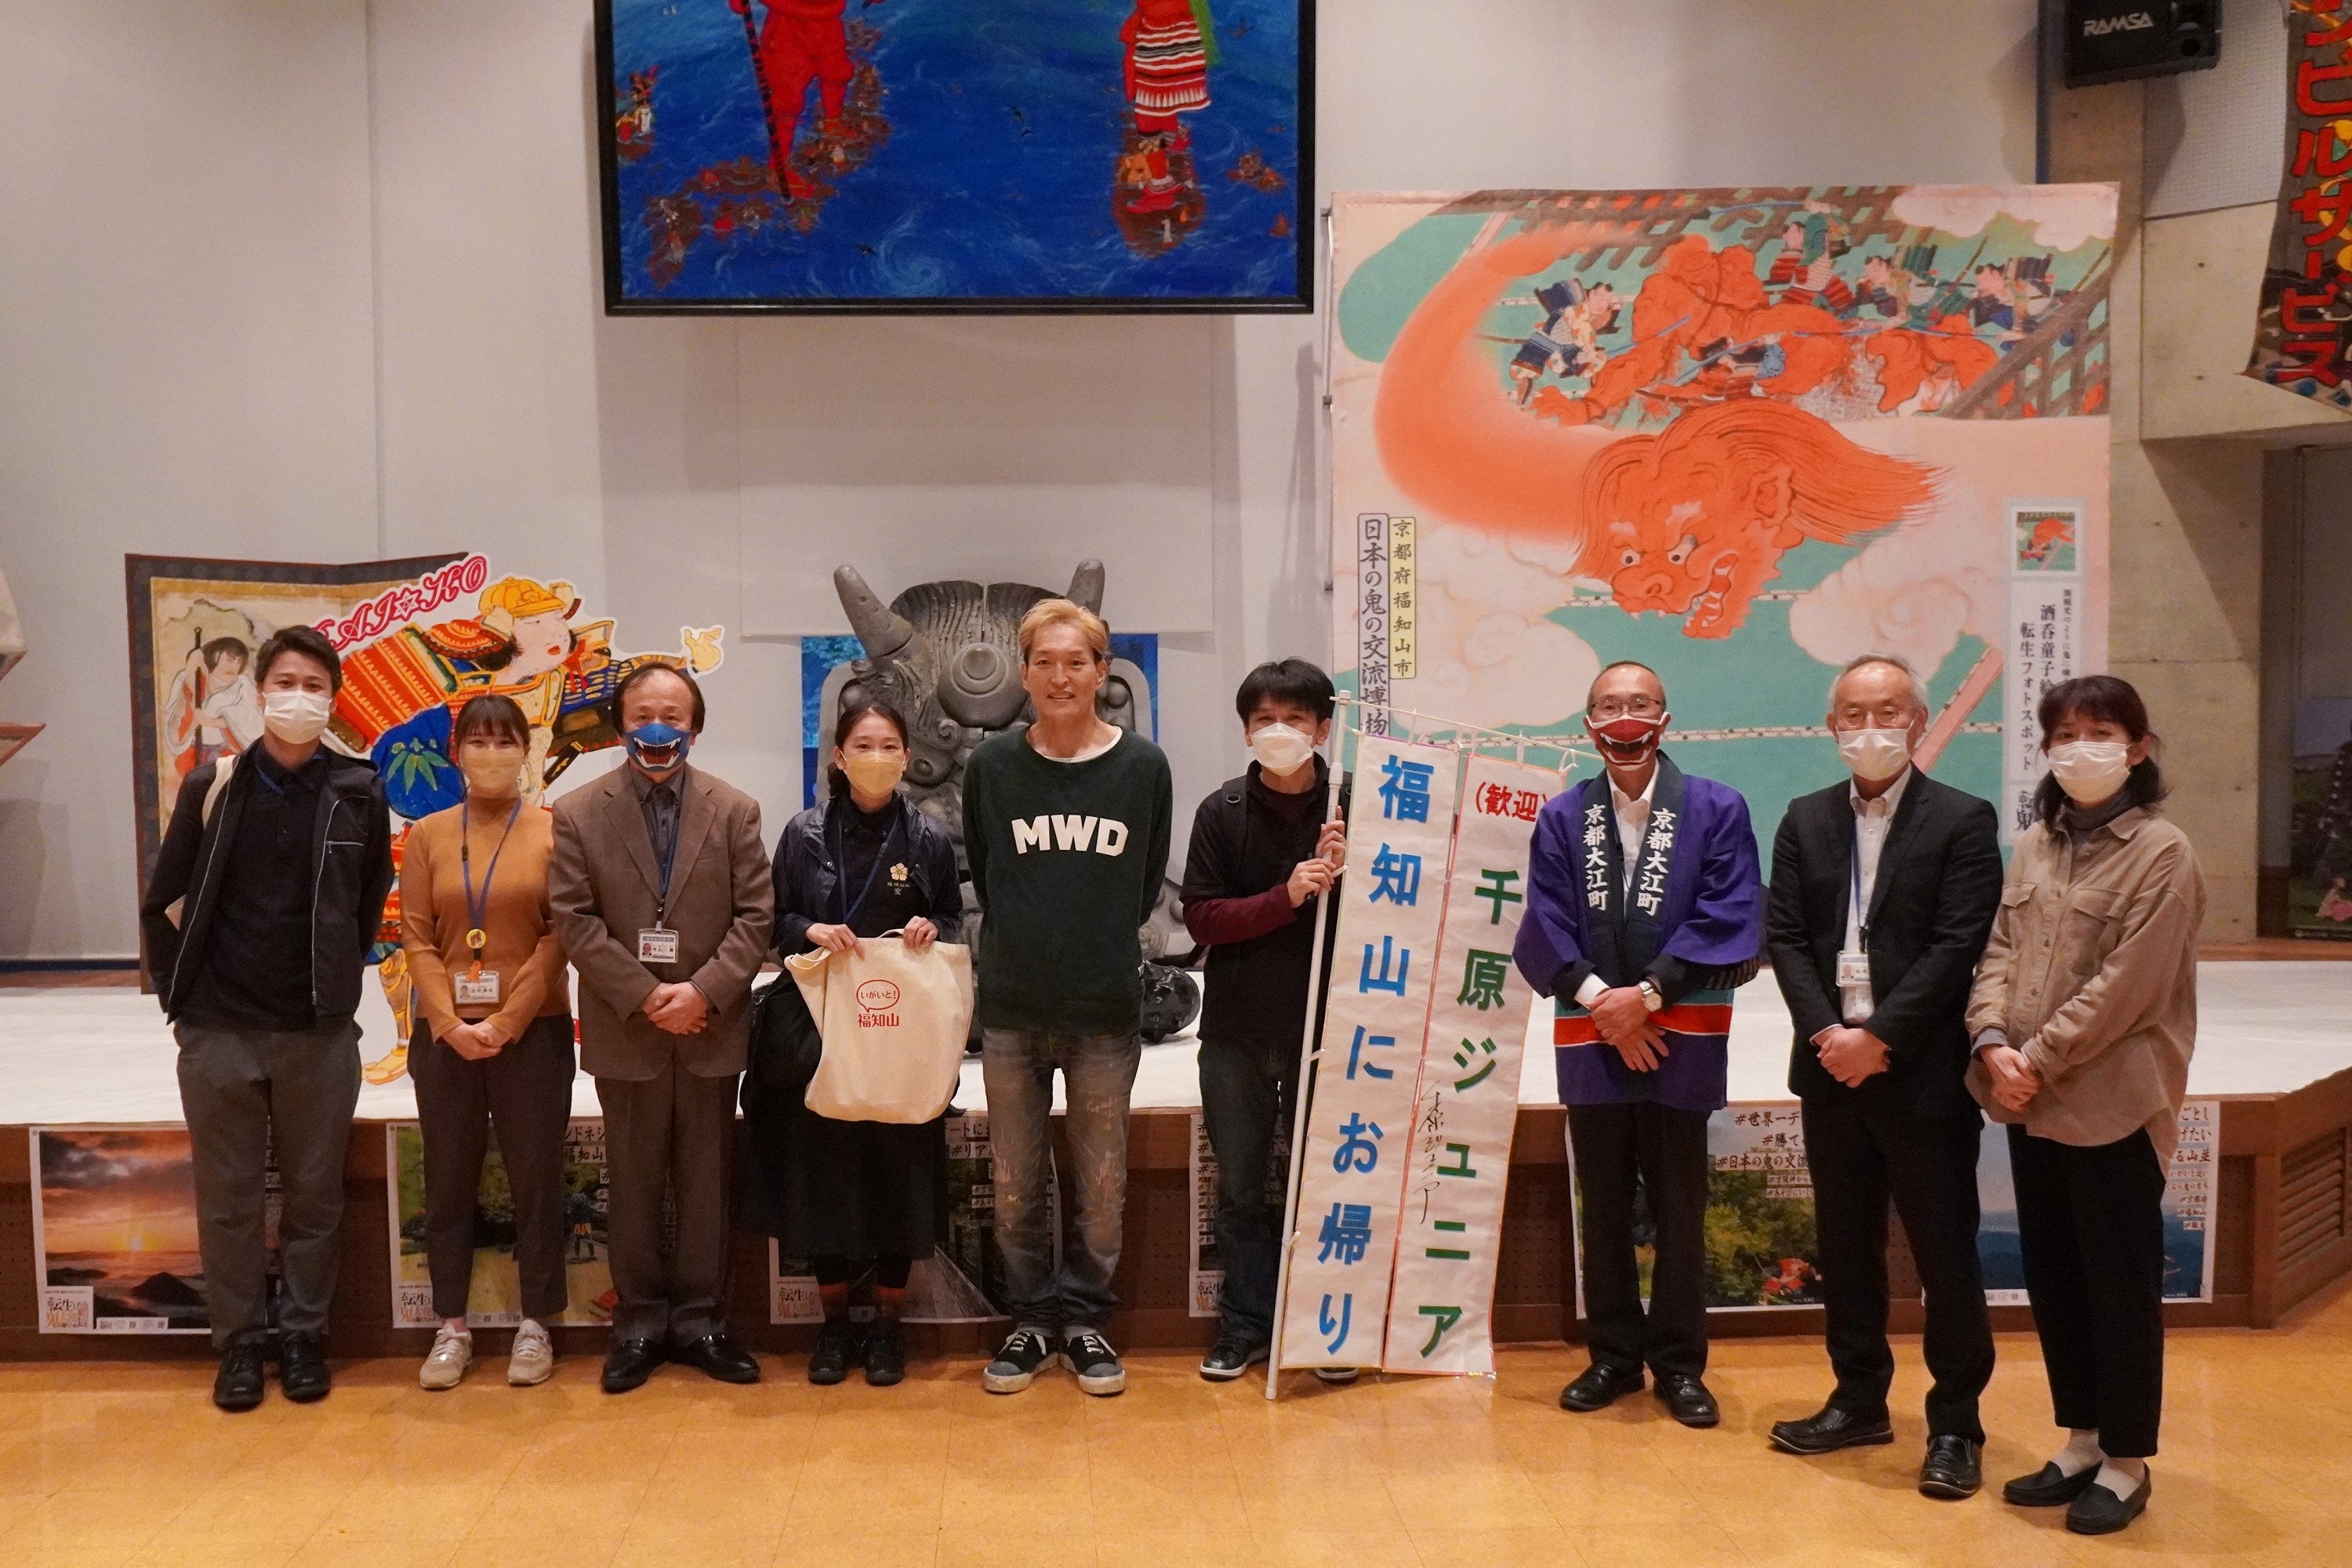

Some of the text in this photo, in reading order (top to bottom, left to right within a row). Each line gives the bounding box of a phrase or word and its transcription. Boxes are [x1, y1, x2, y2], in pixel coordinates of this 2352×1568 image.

[2083, 12, 2154, 37] RAMSA
[1360, 519, 1387, 735] 日本の鬼の交流博物
[1393, 520, 1411, 677] 京都府福知山市
[2020, 622, 2034, 771] 転生フォトスポット
[1011, 815, 1129, 857] MWD
[1583, 804, 1608, 911] 京都大江町
[1637, 808, 1676, 916] 京都大江町
[858, 1013, 899, 1027] 福知山
[1318, 755, 1434, 1354] 福知山にお帰り
[564, 1147, 604, 1163] 福知山
[1418, 869, 1523, 1357] 千原ジュニア
[1762, 1132, 1804, 1147] #勝て
